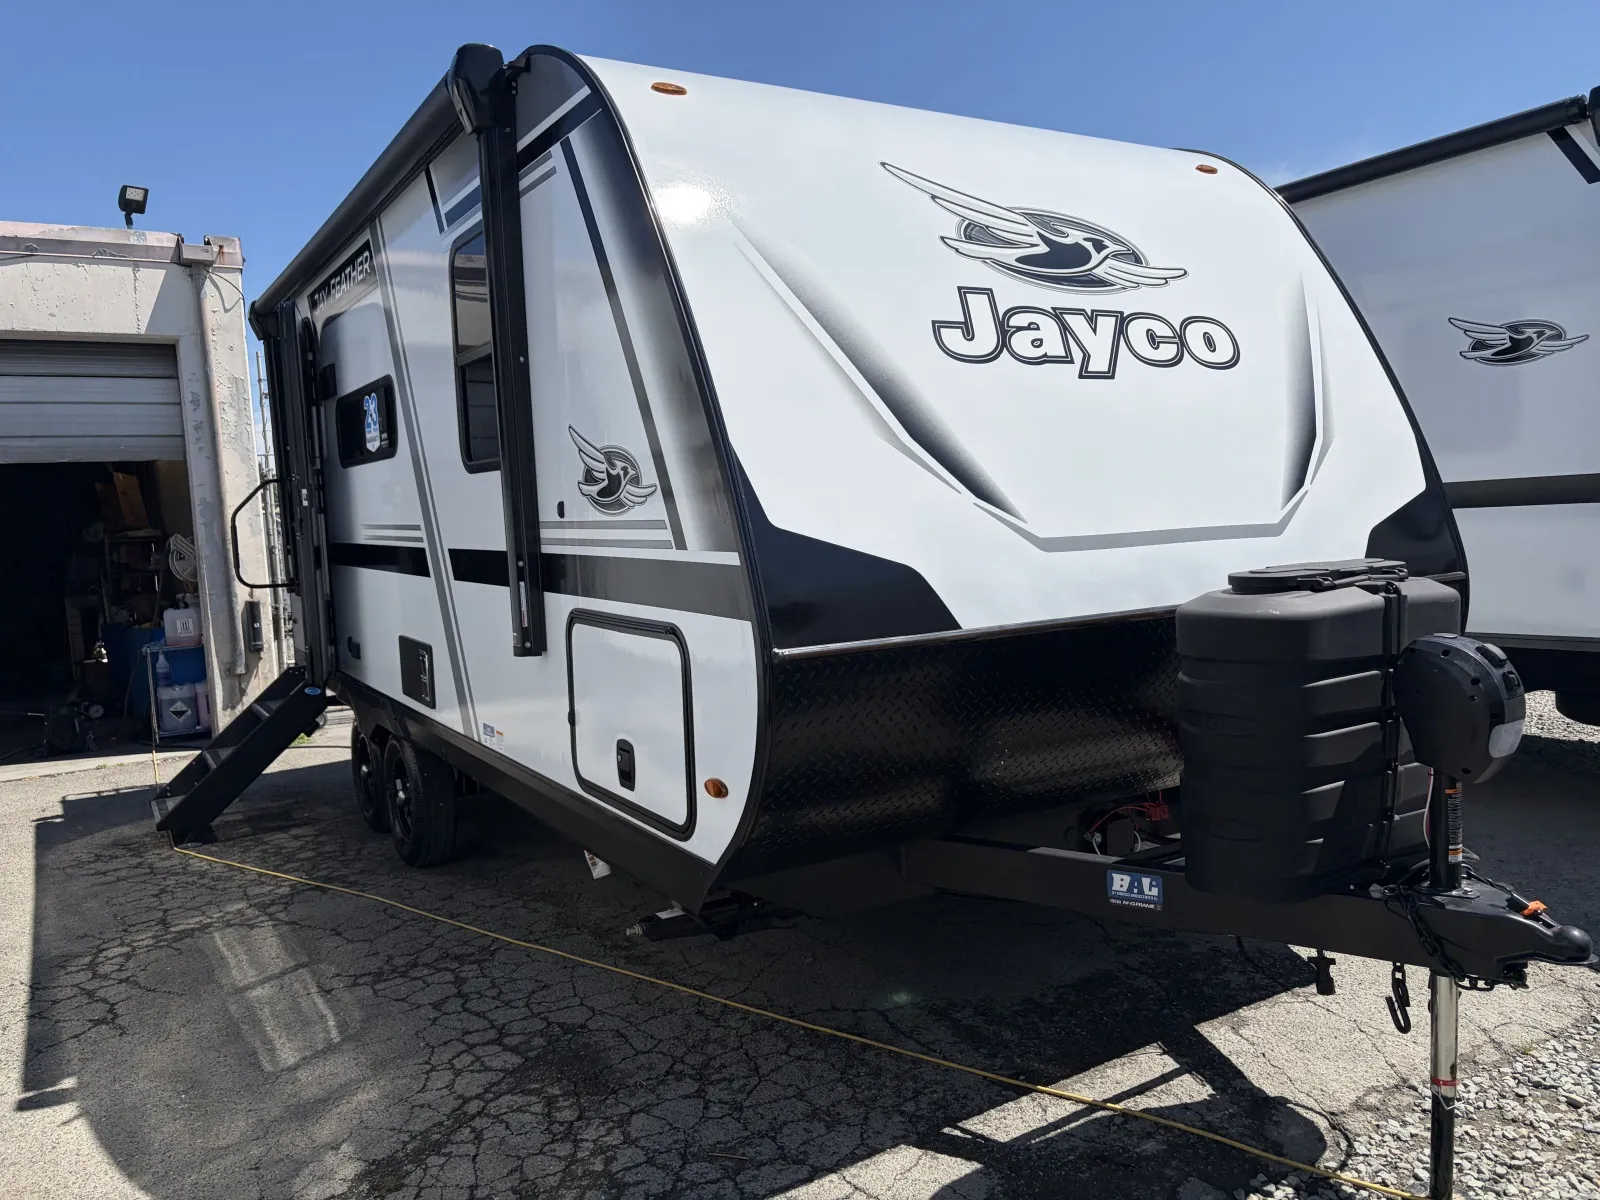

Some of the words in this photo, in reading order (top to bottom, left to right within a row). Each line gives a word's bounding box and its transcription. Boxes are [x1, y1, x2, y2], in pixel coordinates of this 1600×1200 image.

[314, 285, 328, 315] JAY
[330, 250, 371, 304] FEATHER
[931, 285, 1242, 380] Jayco
